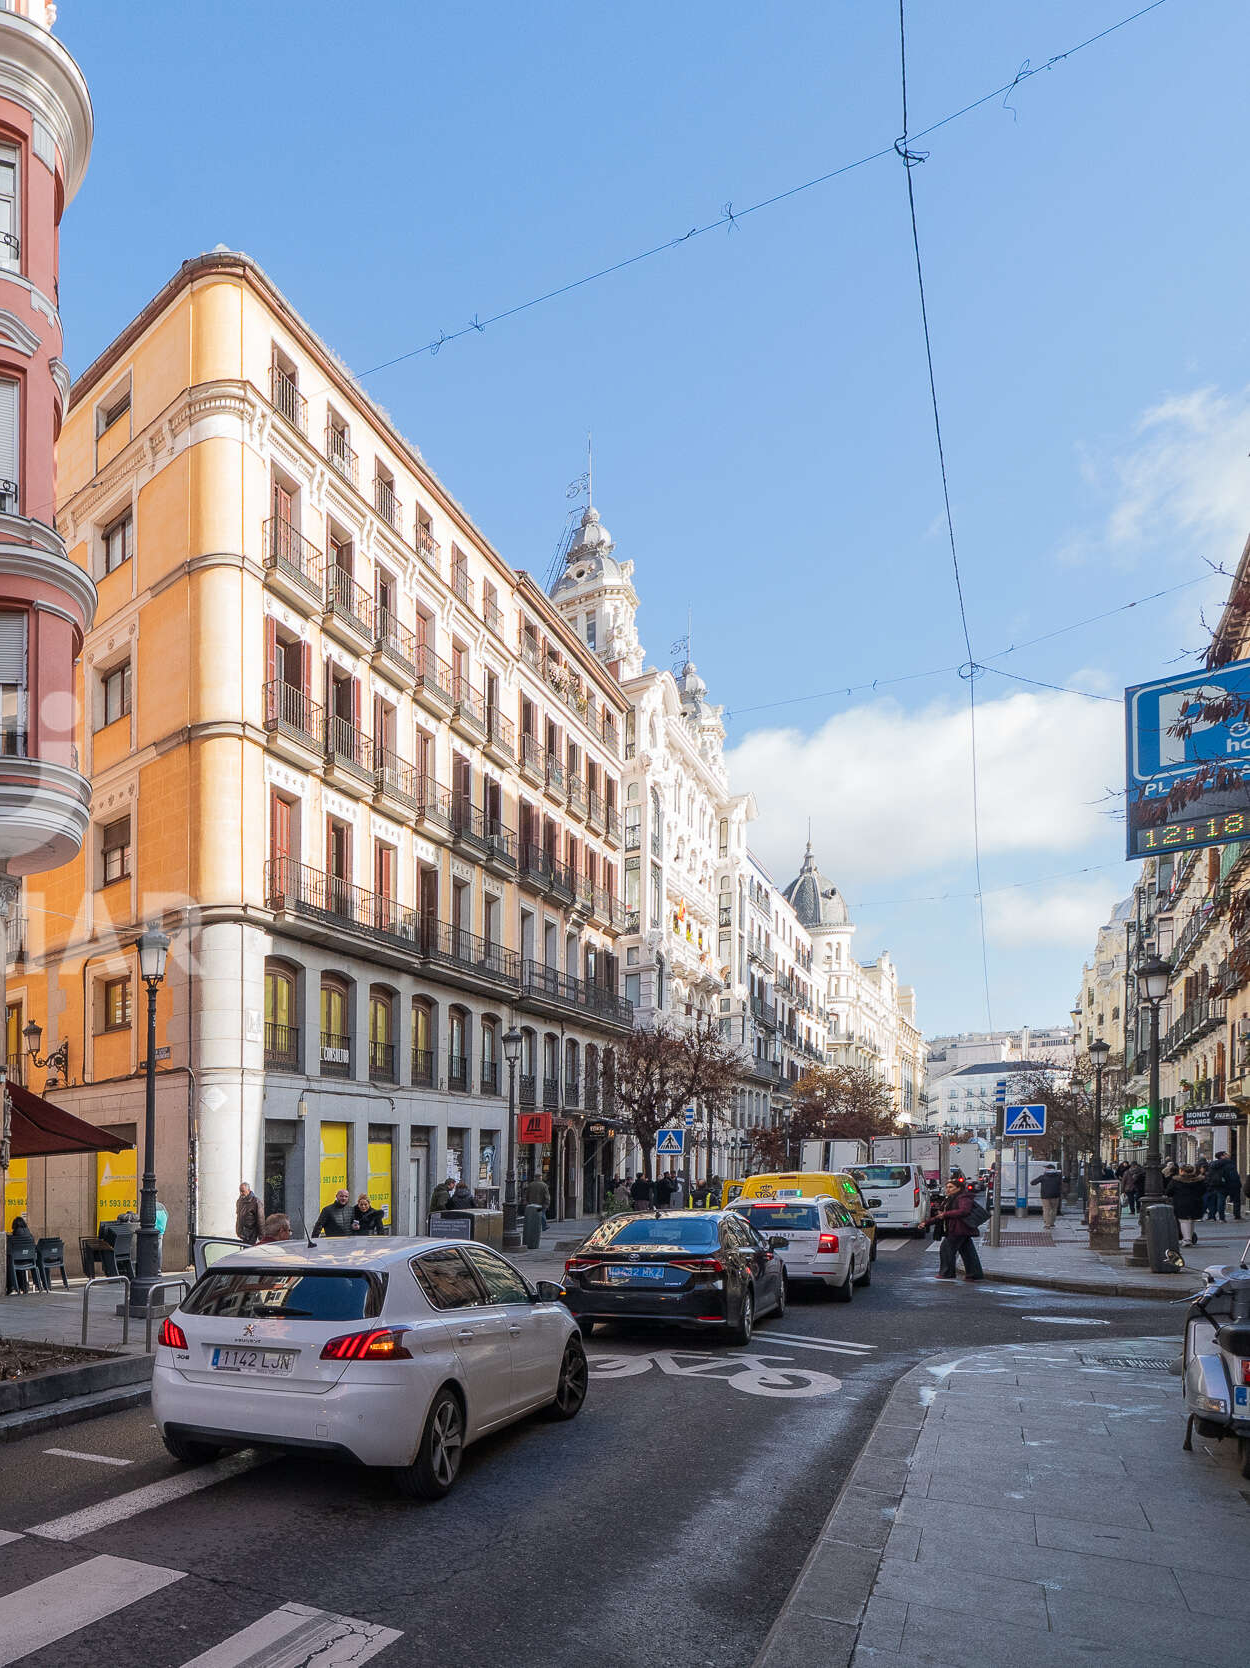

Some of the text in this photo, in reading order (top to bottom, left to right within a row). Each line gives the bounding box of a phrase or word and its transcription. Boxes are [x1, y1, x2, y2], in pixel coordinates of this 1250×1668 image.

[1146, 813, 1244, 848] 12:18
[1126, 1115, 1144, 1125] 24
[1185, 1118, 1211, 1126] CHANGE
[99, 1199, 107, 1207] 91
[109, 1199, 121, 1208] 593
[224, 1351, 290, 1370] 1142 LJN
